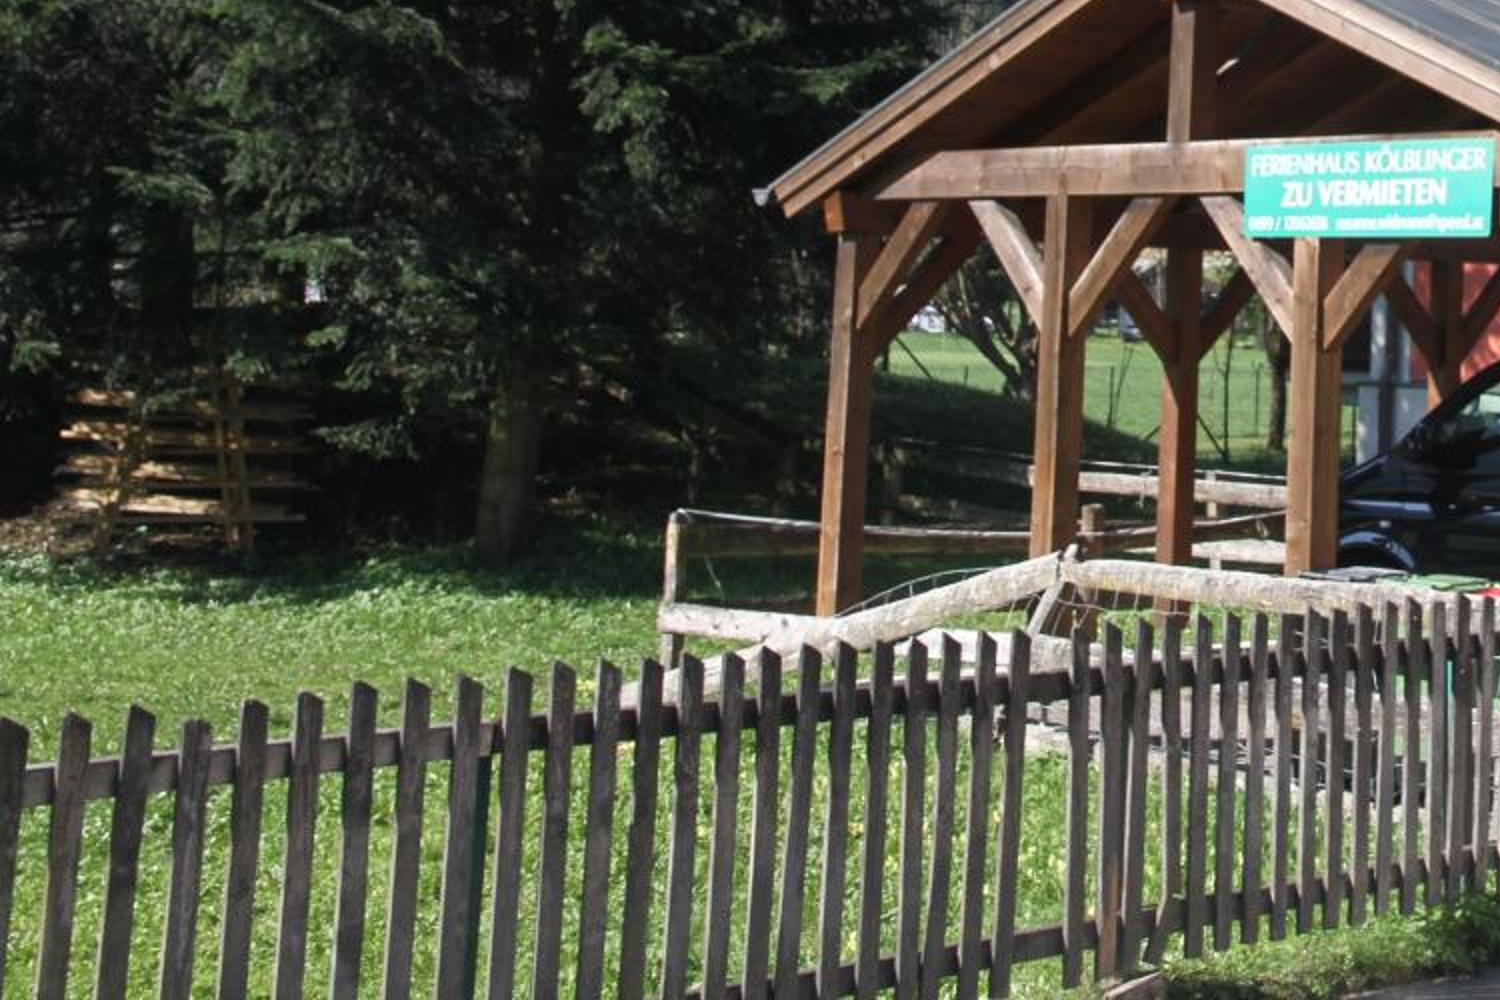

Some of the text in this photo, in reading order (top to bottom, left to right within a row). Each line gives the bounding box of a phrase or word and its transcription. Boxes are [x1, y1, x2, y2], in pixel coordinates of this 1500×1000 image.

[1251, 151, 1360, 176] FERIENHAUS
[1280, 178, 1448, 208] ZU VERMIETEN
